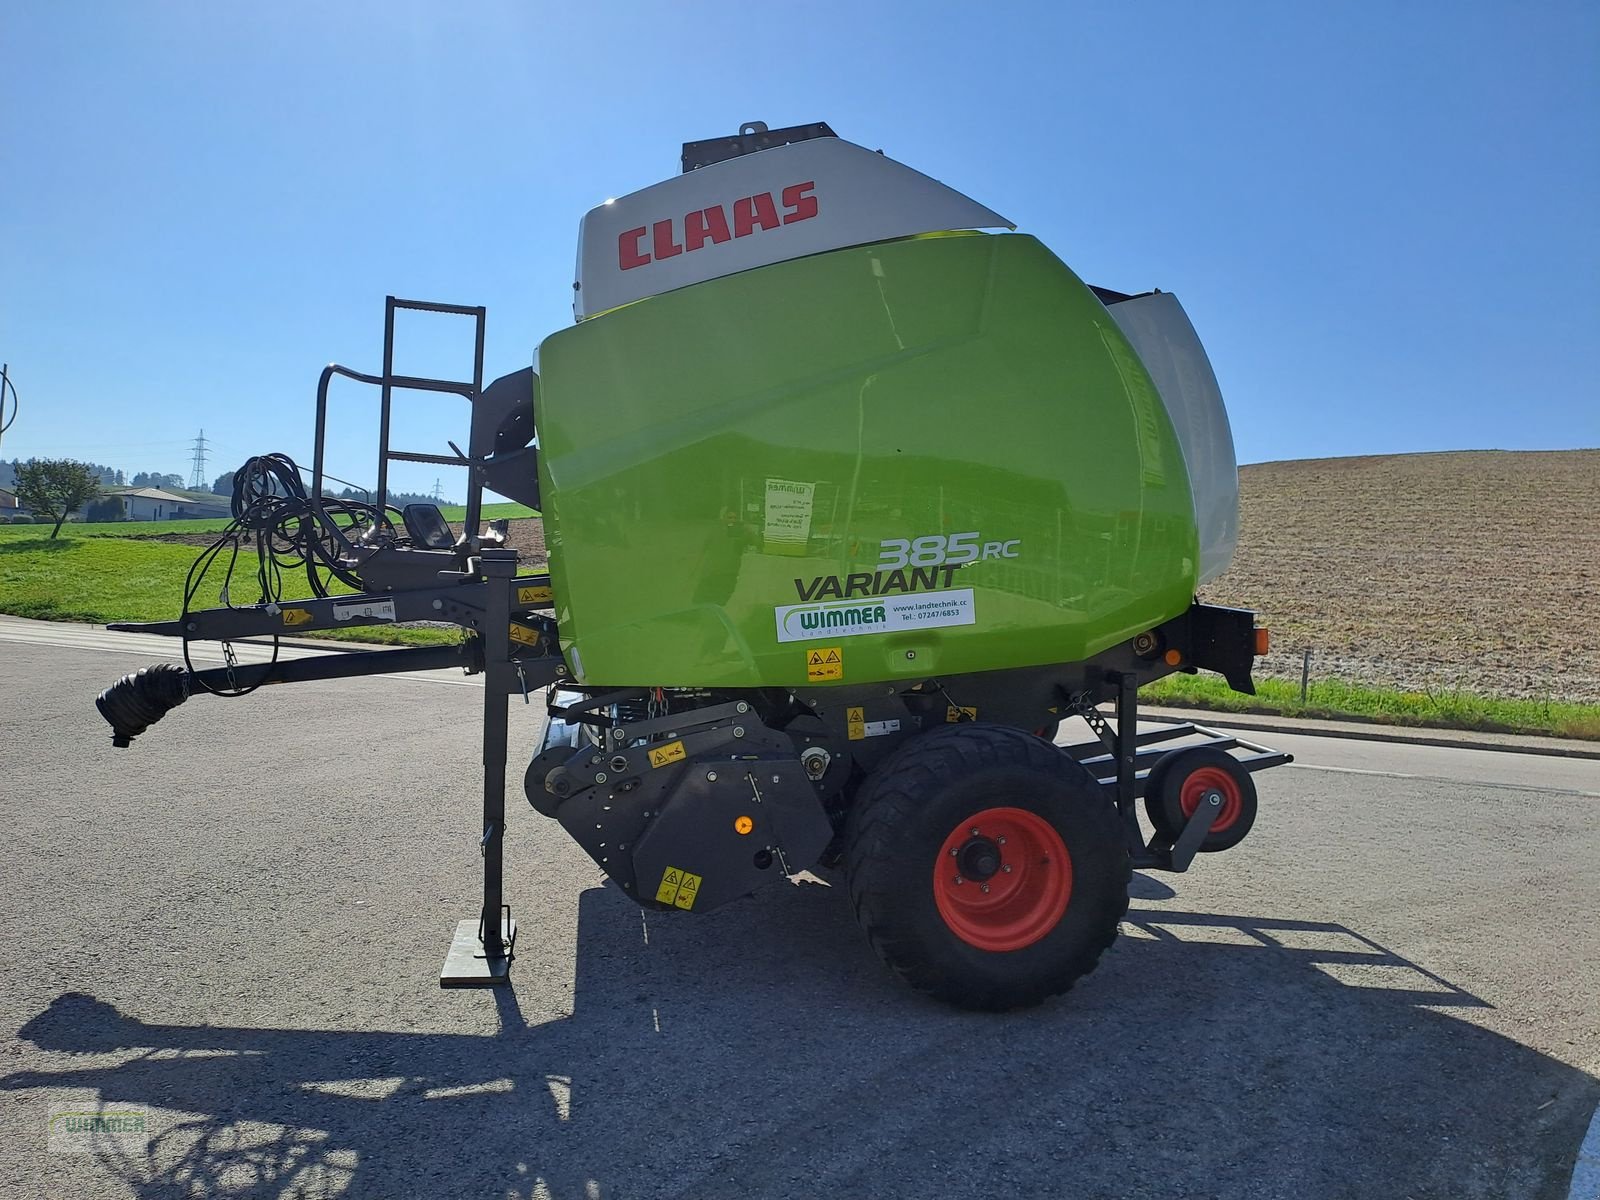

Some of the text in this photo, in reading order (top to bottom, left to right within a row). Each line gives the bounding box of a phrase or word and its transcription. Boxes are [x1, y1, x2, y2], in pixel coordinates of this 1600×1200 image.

[618, 181, 818, 271] CLAAS
[877, 531, 1022, 571] 385 RC
[794, 563, 963, 602] VARIANT
[800, 606, 886, 630] WIMMER
[893, 599, 967, 612] www.landtechnik.cc
[901, 608, 960, 621] Tel.: 07247/6853
